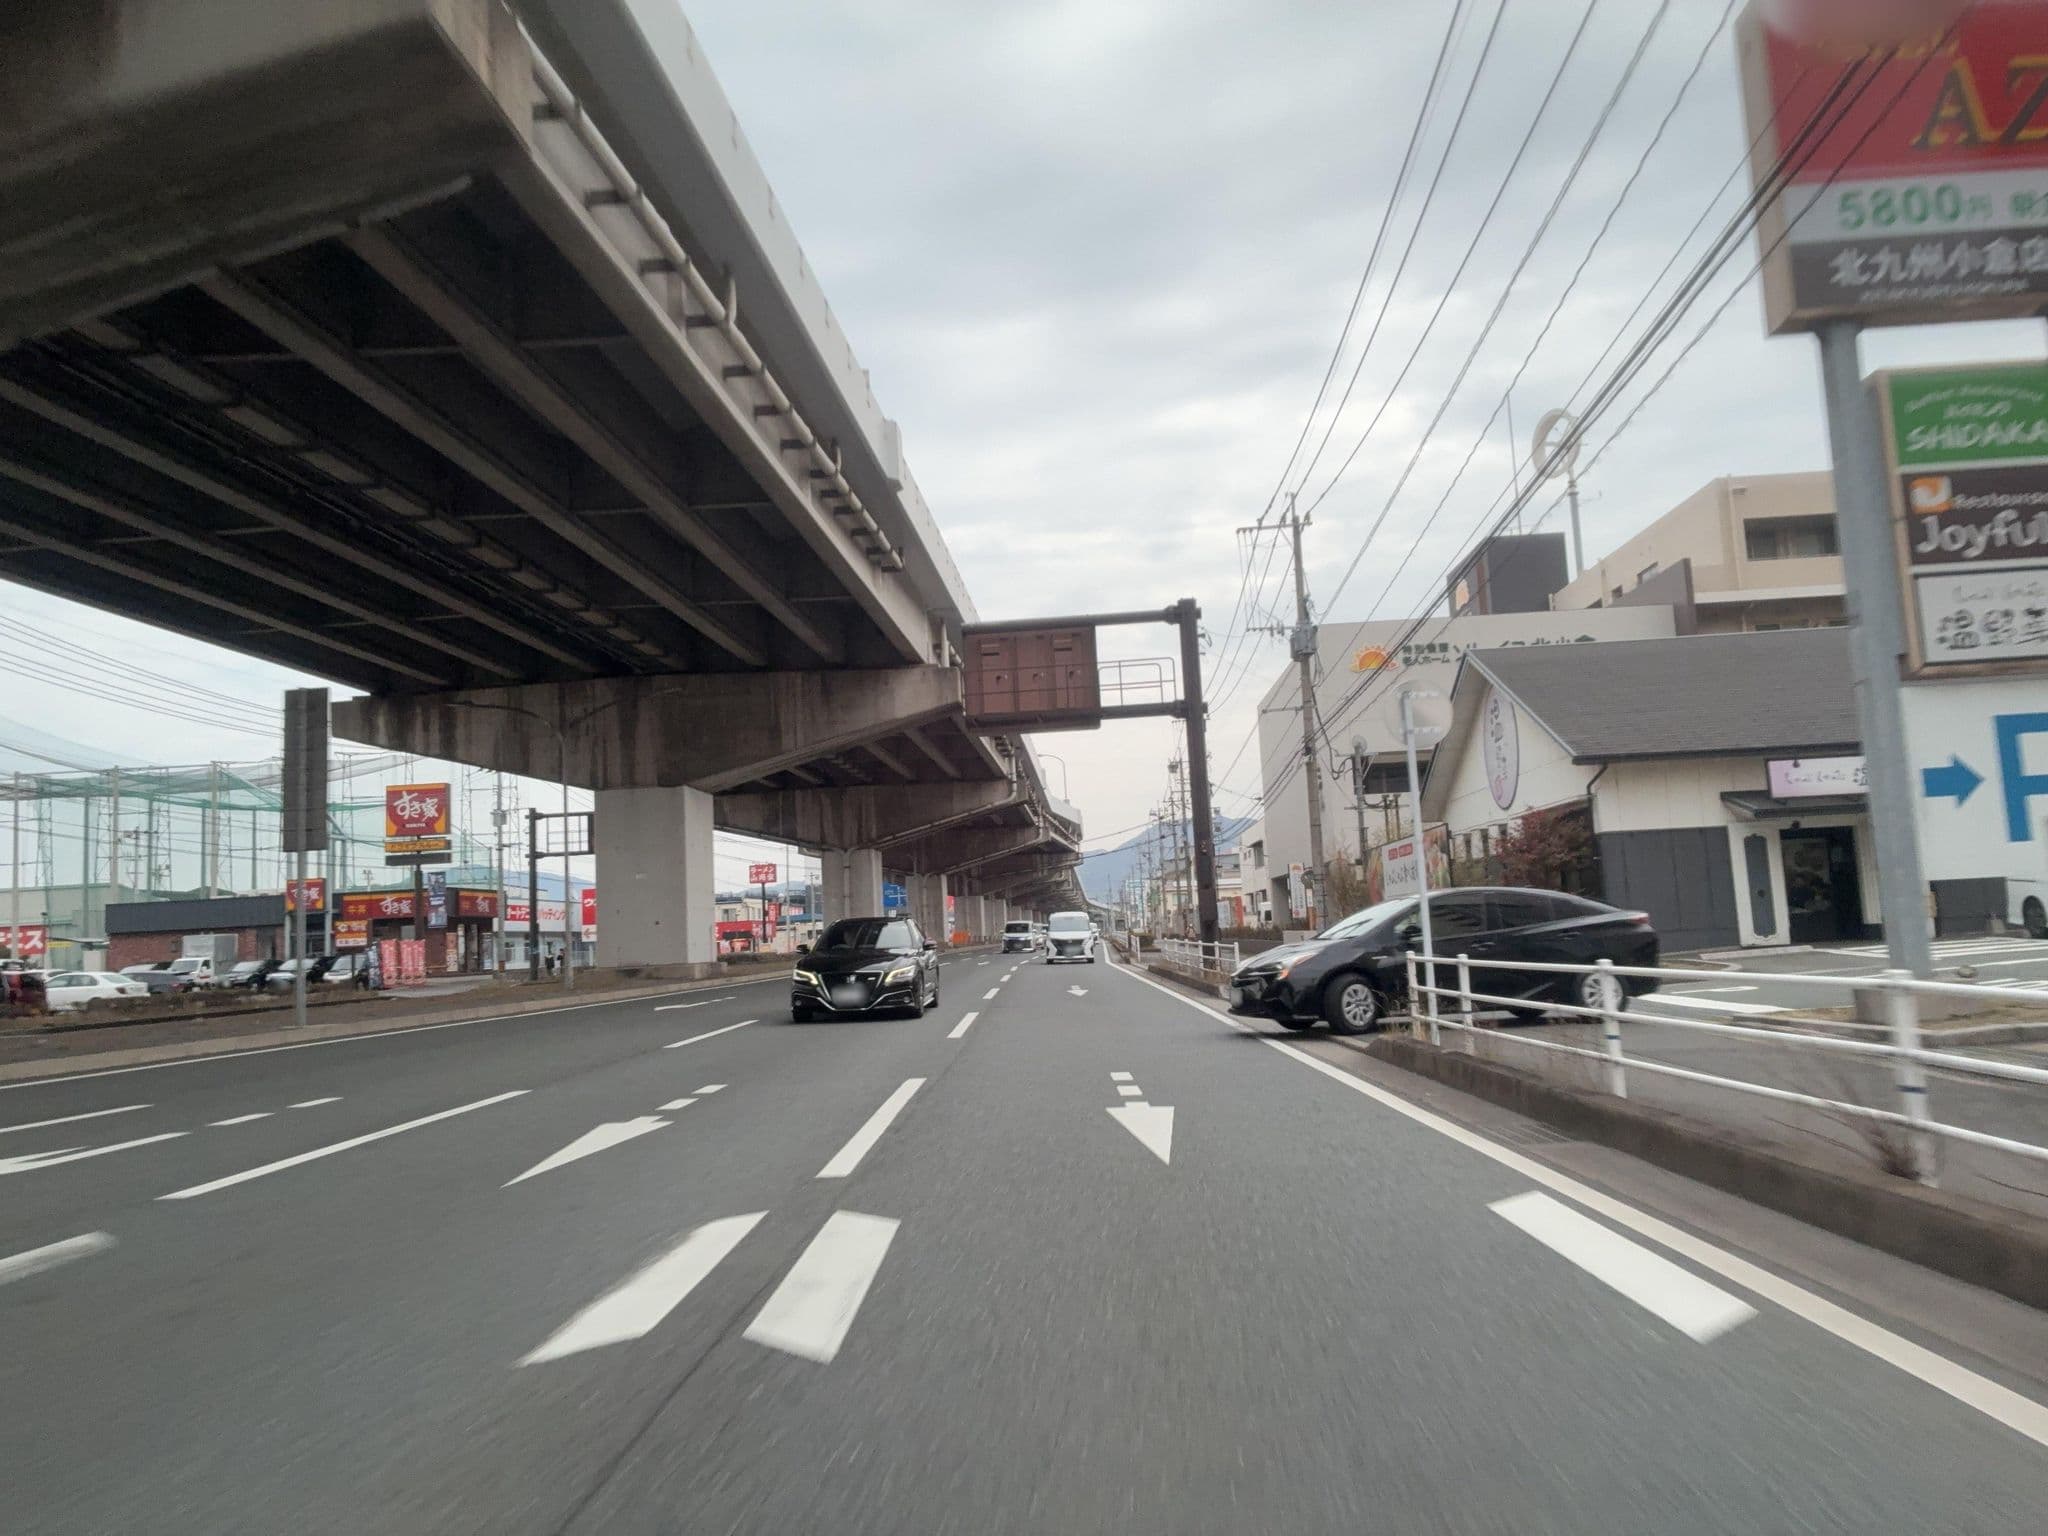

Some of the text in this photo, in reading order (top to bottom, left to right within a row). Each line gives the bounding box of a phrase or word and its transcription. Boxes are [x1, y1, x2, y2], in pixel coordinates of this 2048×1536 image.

[393, 790, 439, 822] すき家
[379, 896, 413, 916] すき家
